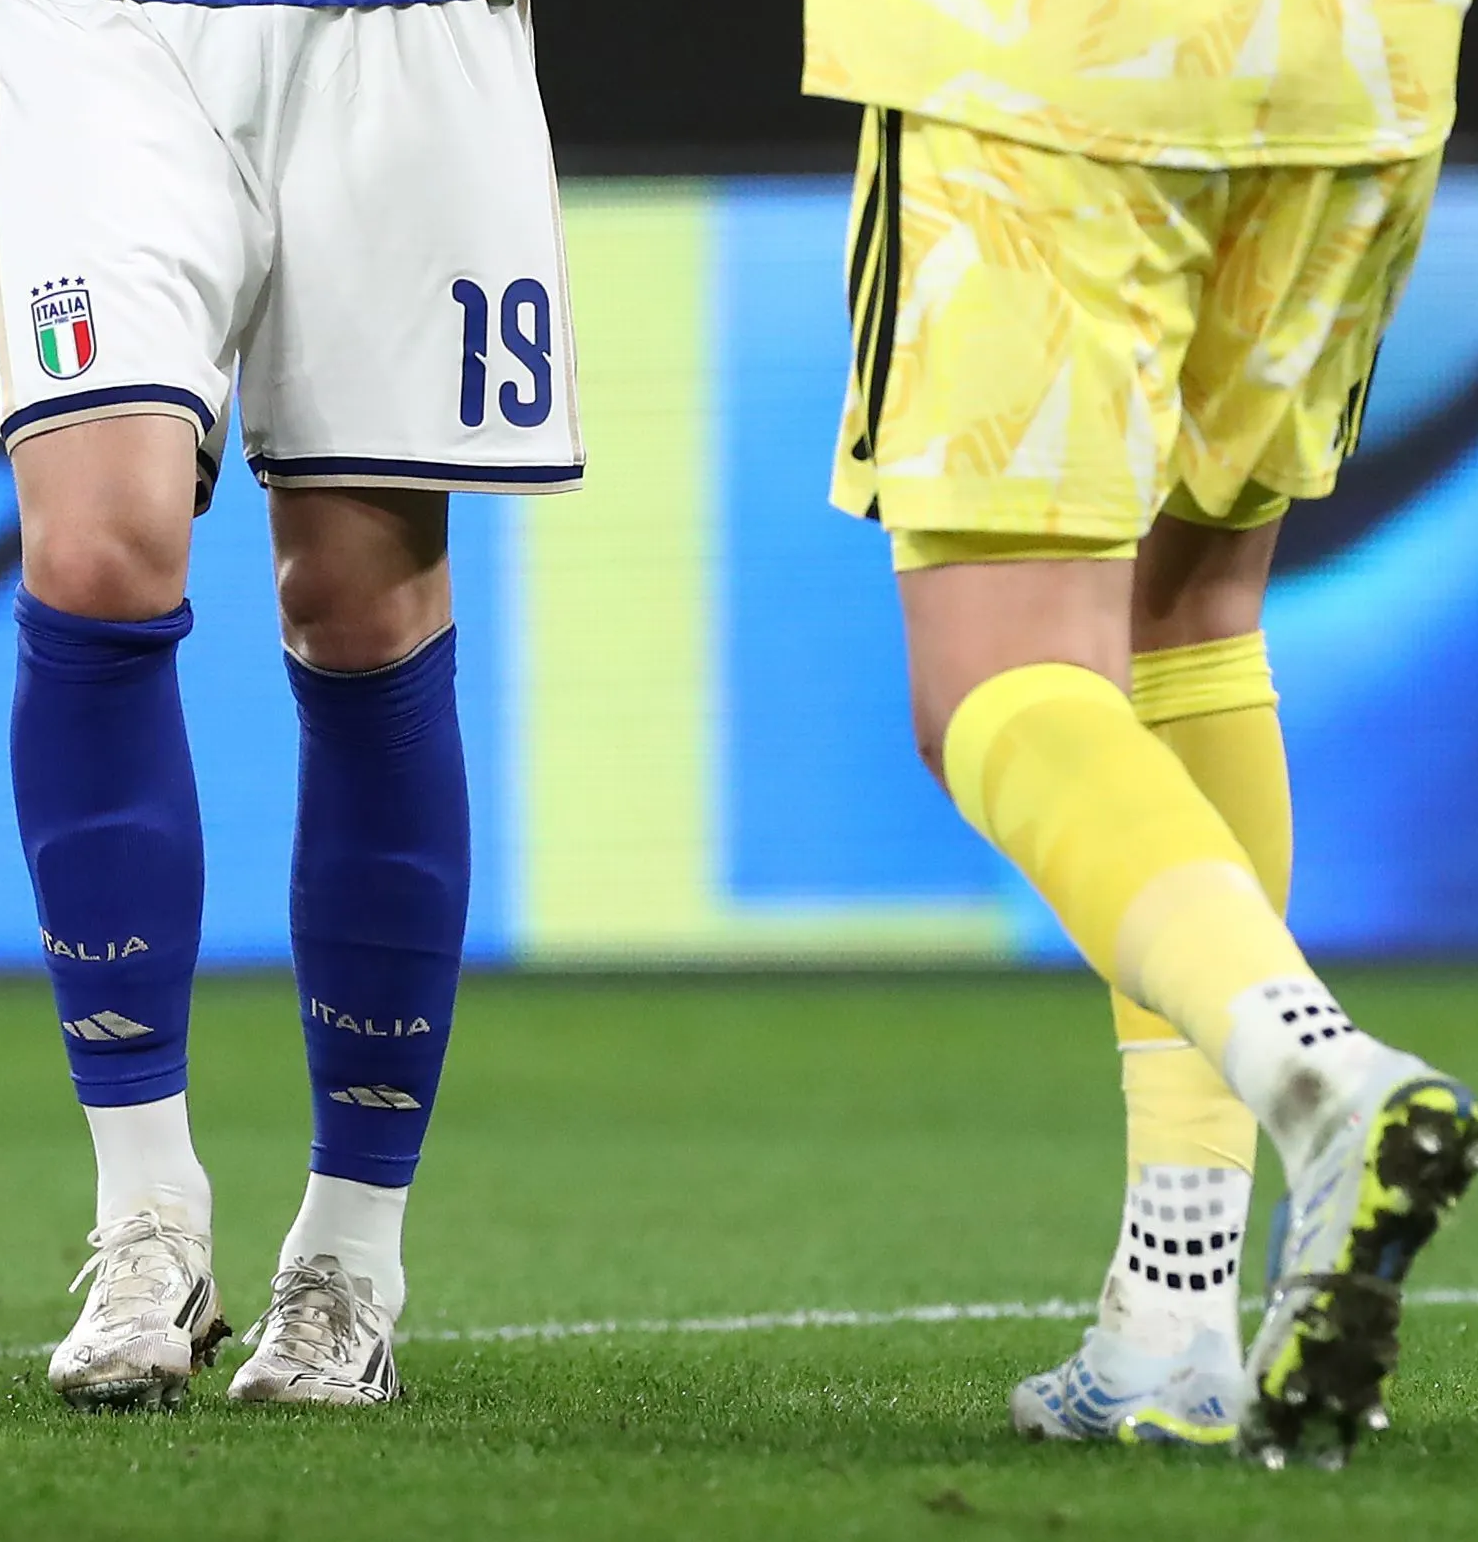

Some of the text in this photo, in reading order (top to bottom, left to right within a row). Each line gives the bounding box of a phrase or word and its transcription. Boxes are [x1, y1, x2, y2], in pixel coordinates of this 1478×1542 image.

[36, 296, 86, 323] ITALIA
[451, 277, 554, 428] 19
[310, 997, 432, 1038] ITALIA
